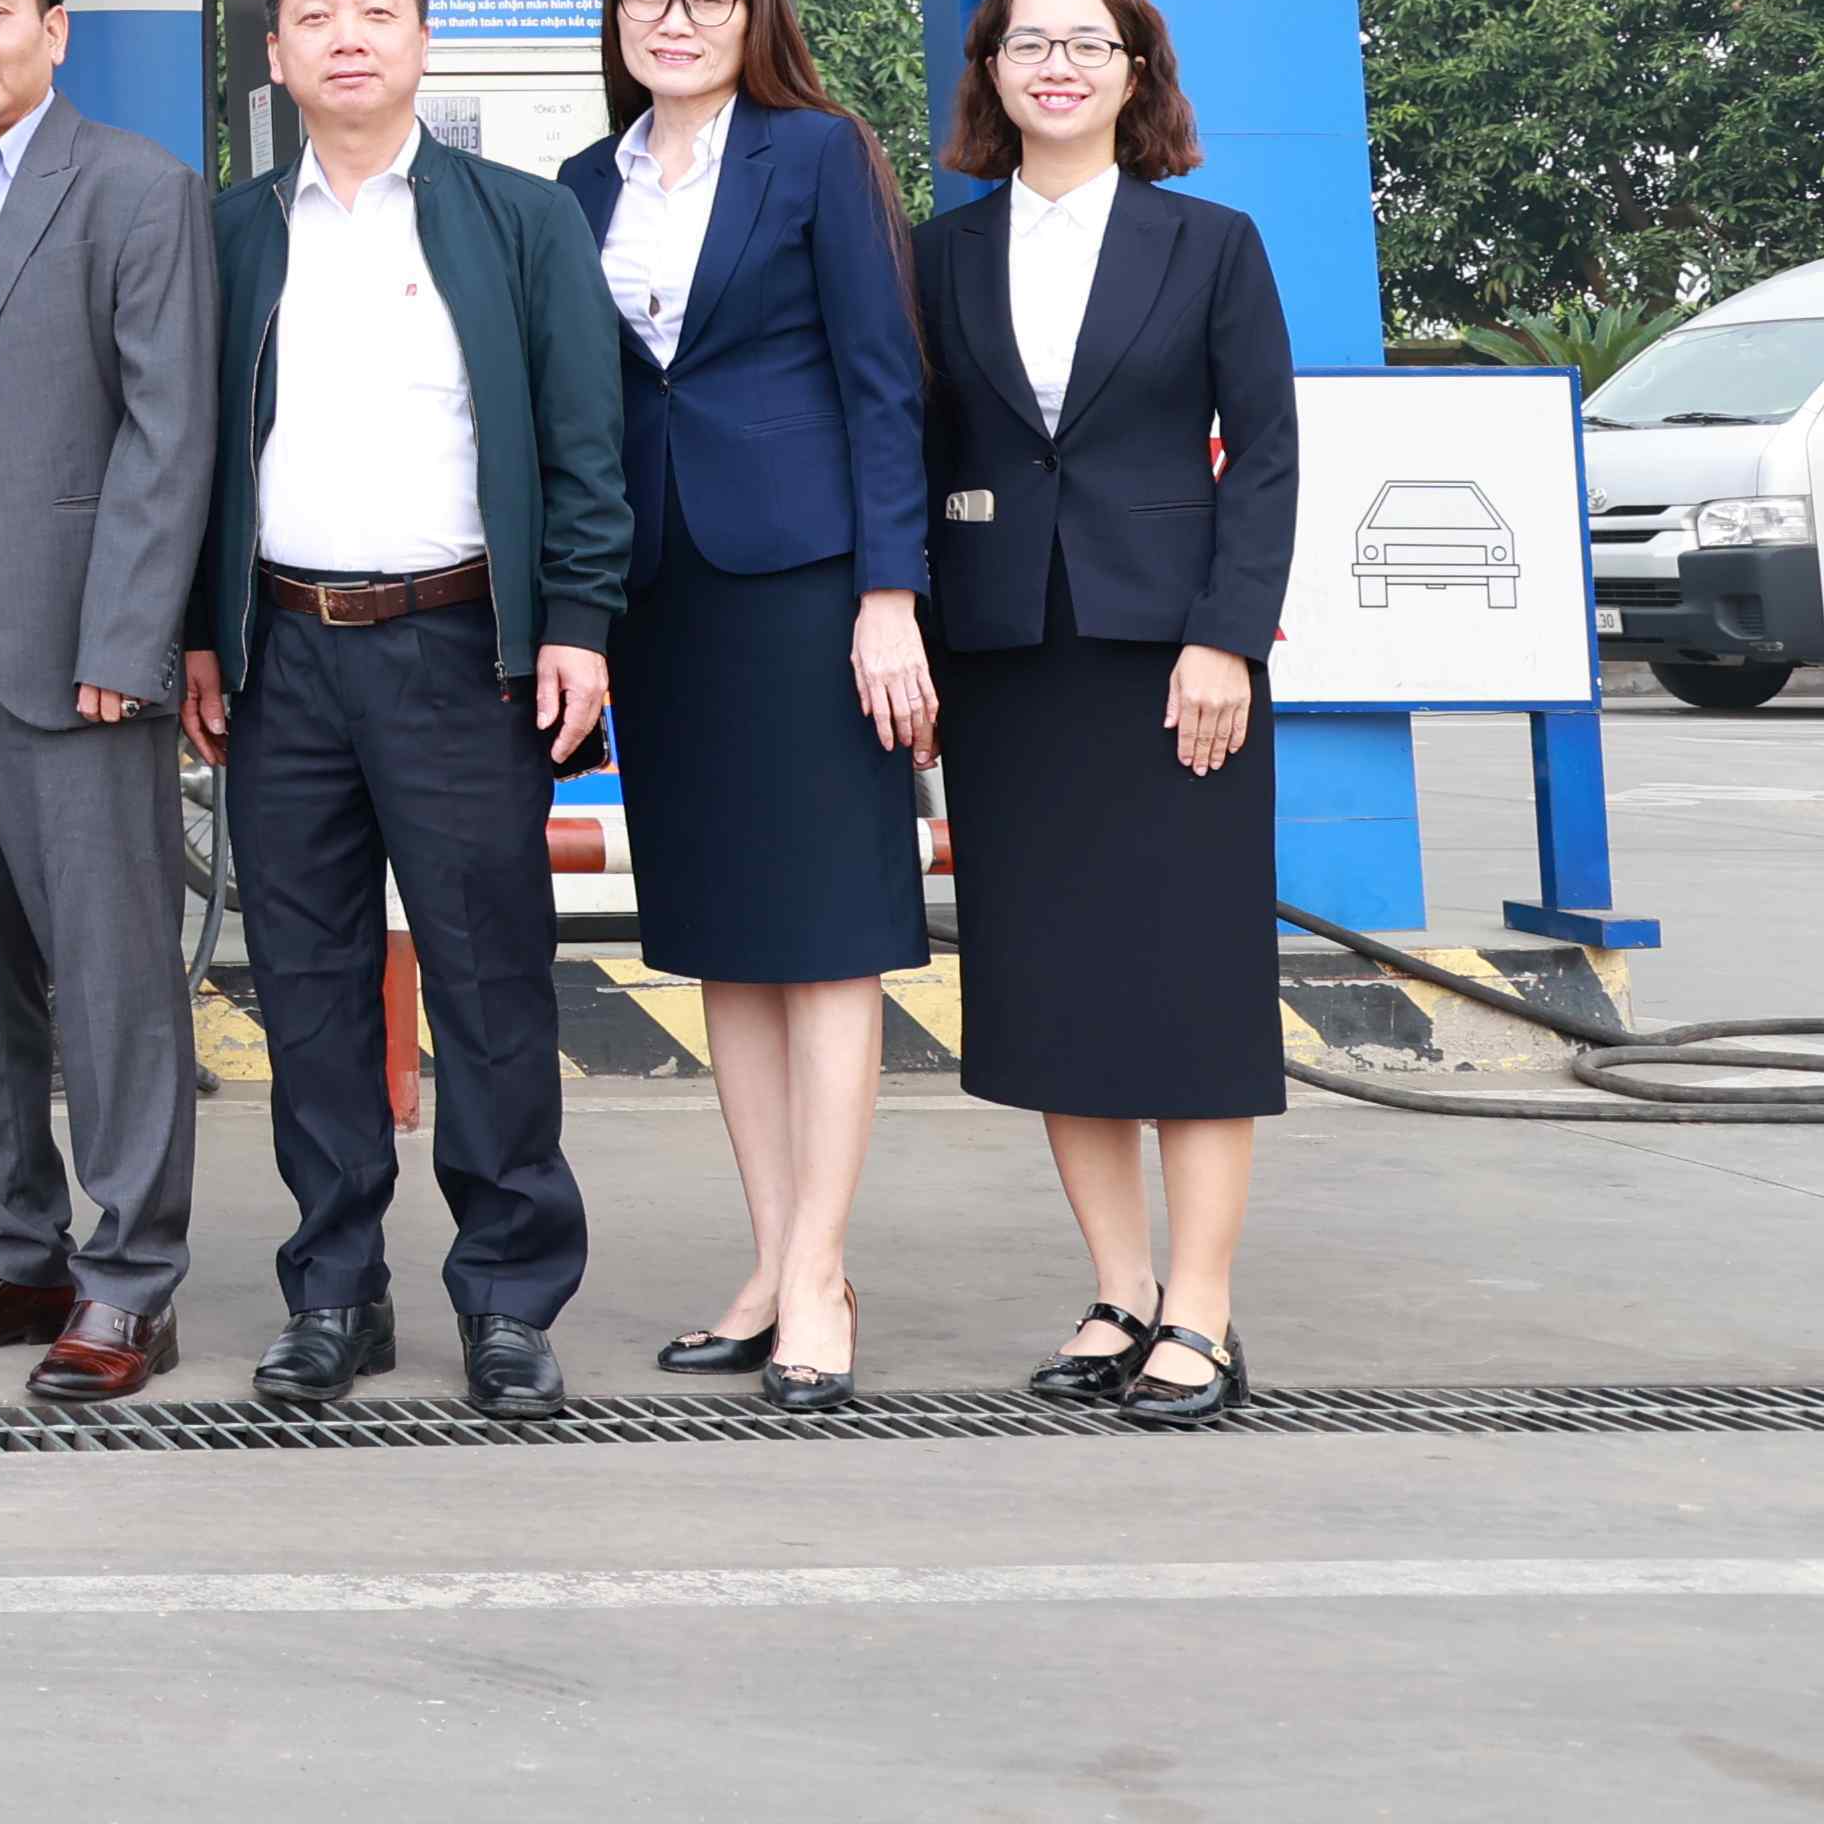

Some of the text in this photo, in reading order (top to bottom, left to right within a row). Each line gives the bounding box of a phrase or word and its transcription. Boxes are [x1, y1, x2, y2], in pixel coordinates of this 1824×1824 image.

[449, 0, 477, 13] hàng
[478, 0, 497, 11] xác
[498, 0, 524, 12] nhận
[525, 0, 549, 10] màn
[550, 0, 574, 10] hình
[448, 17, 479, 28] thanh
[480, 17, 504, 28] toán
[519, 17, 539, 27] xác
[540, 16, 567, 29] nhận
